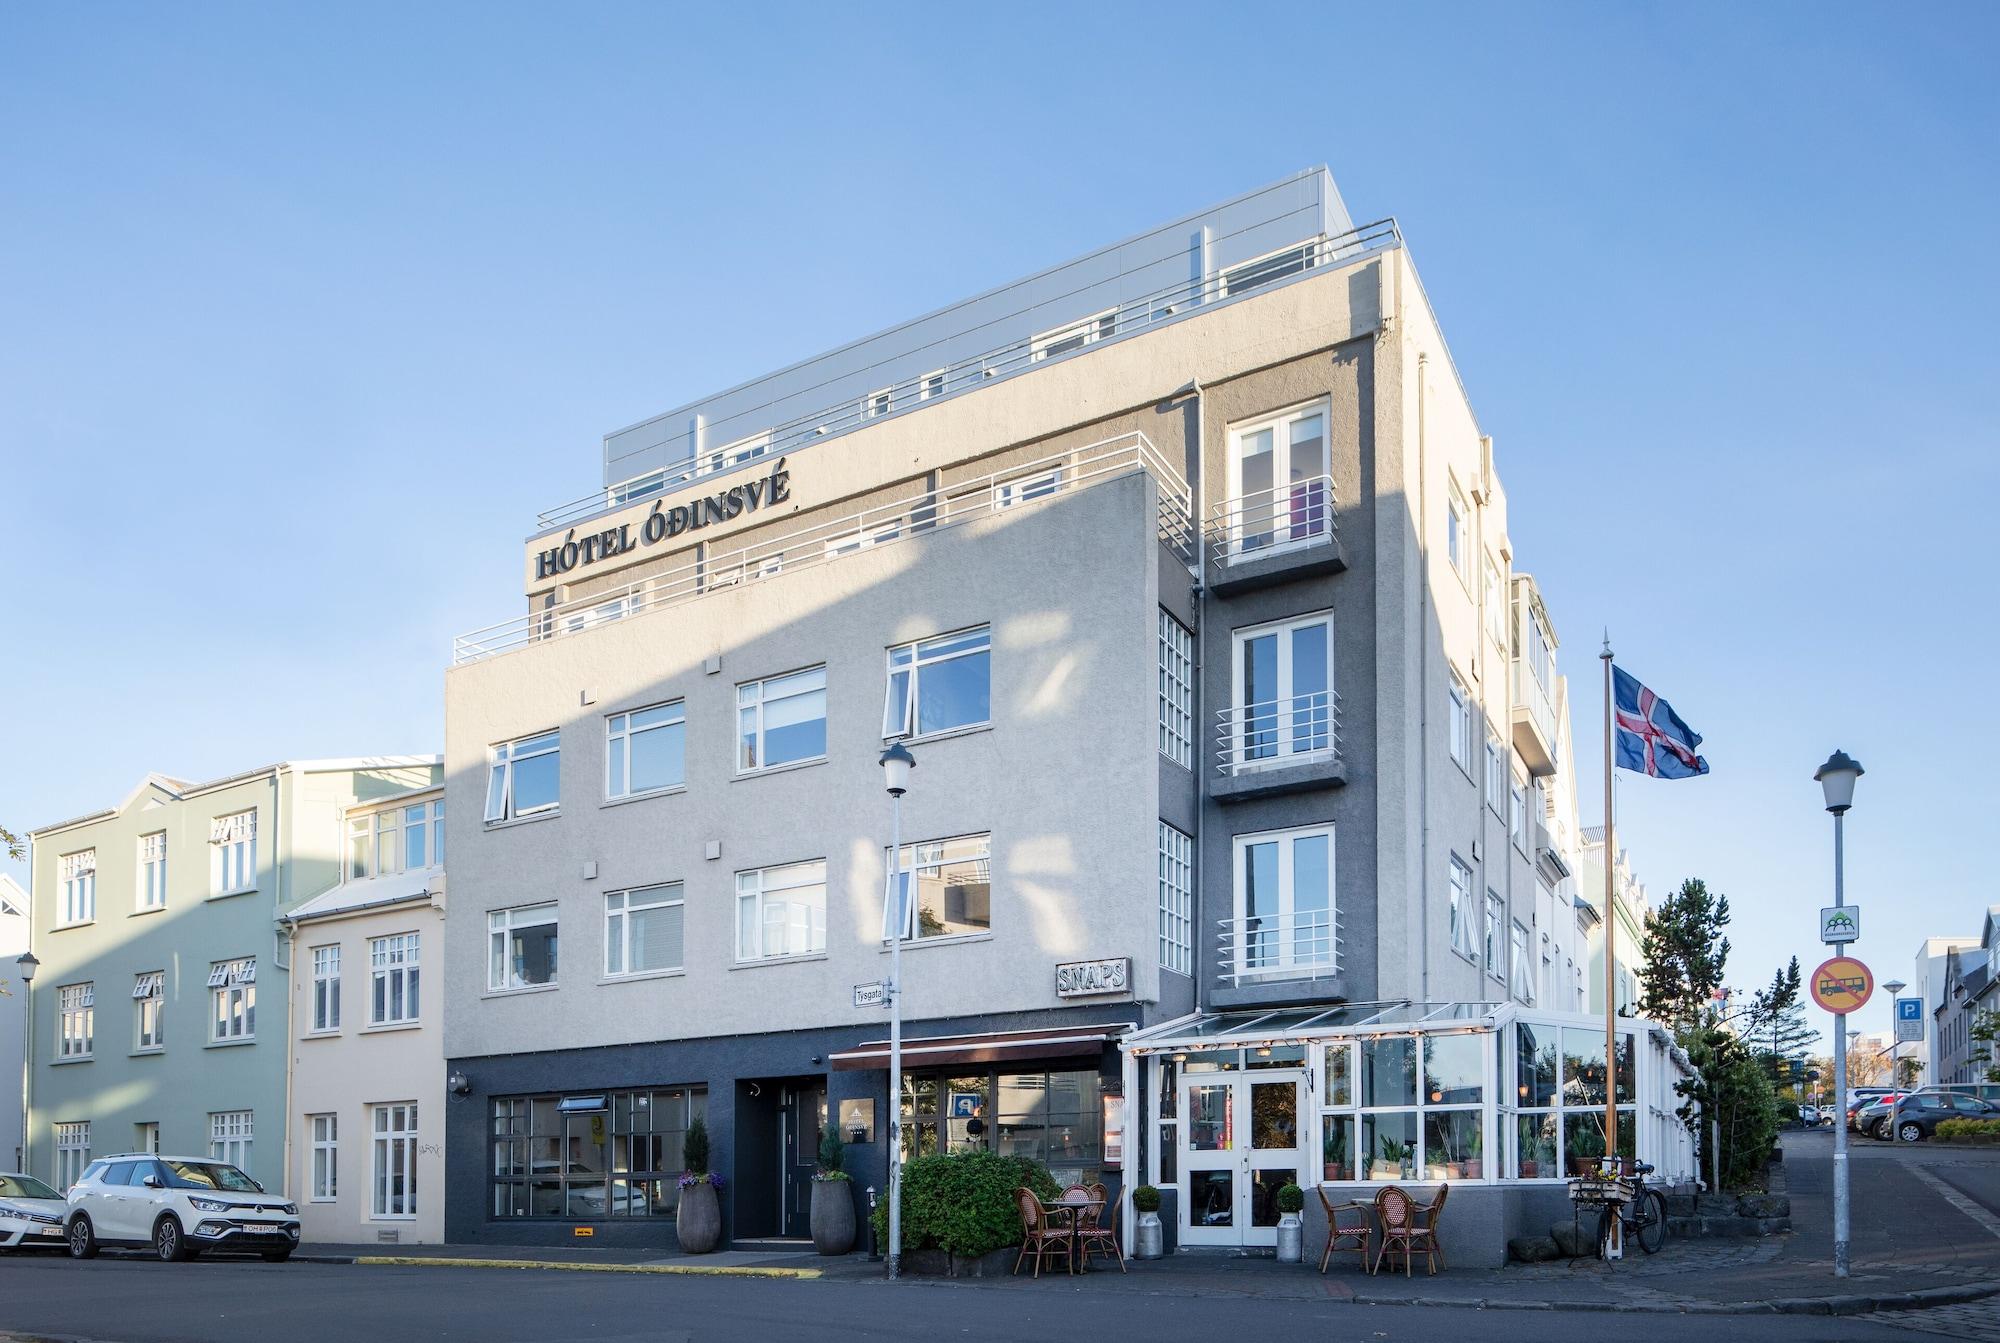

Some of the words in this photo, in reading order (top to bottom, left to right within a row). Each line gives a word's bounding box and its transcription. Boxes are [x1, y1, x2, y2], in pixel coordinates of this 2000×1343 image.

[537, 528, 637, 580] HÓTEL
[1059, 963, 1125, 992] SNAPS
[1904, 1004, 1915, 1017] P
